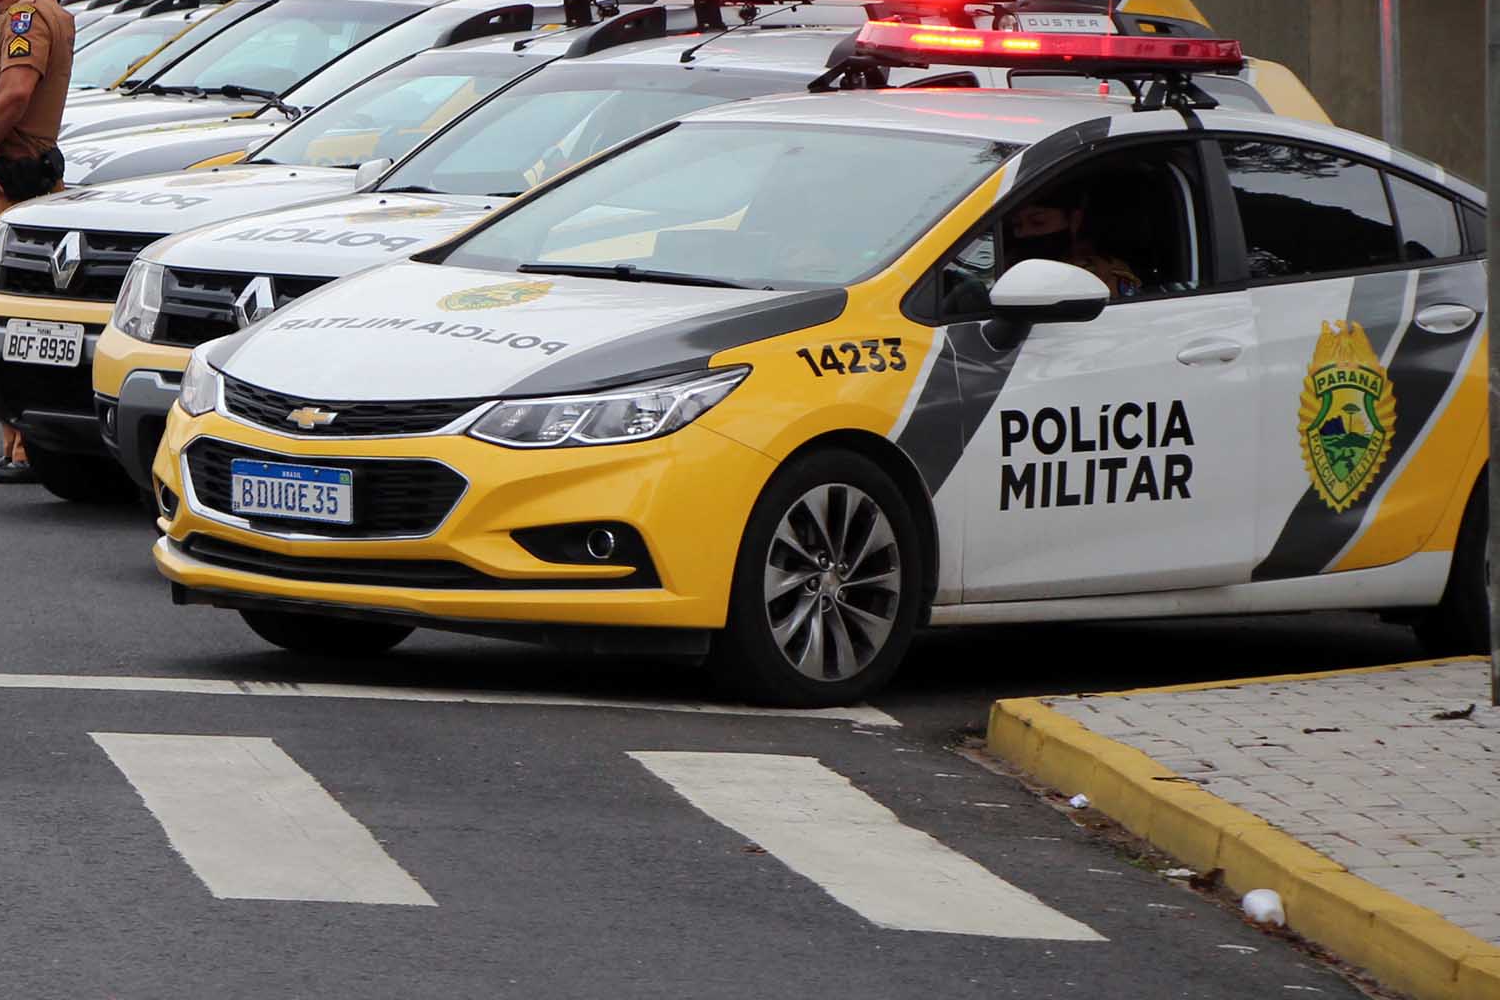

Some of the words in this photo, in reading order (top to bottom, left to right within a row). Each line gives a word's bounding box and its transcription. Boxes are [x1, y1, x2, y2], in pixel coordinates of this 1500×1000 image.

[1028, 18, 1100, 28] DUSTER
[796, 338, 906, 377] 14233
[1317, 370, 1379, 394] PARANÁ
[1001, 400, 1195, 457] POLÍCIA
[282, 471, 302, 479] BRASIL
[1000, 454, 1192, 511] MILITAR
[1346, 436, 1381, 490] MILITAR
